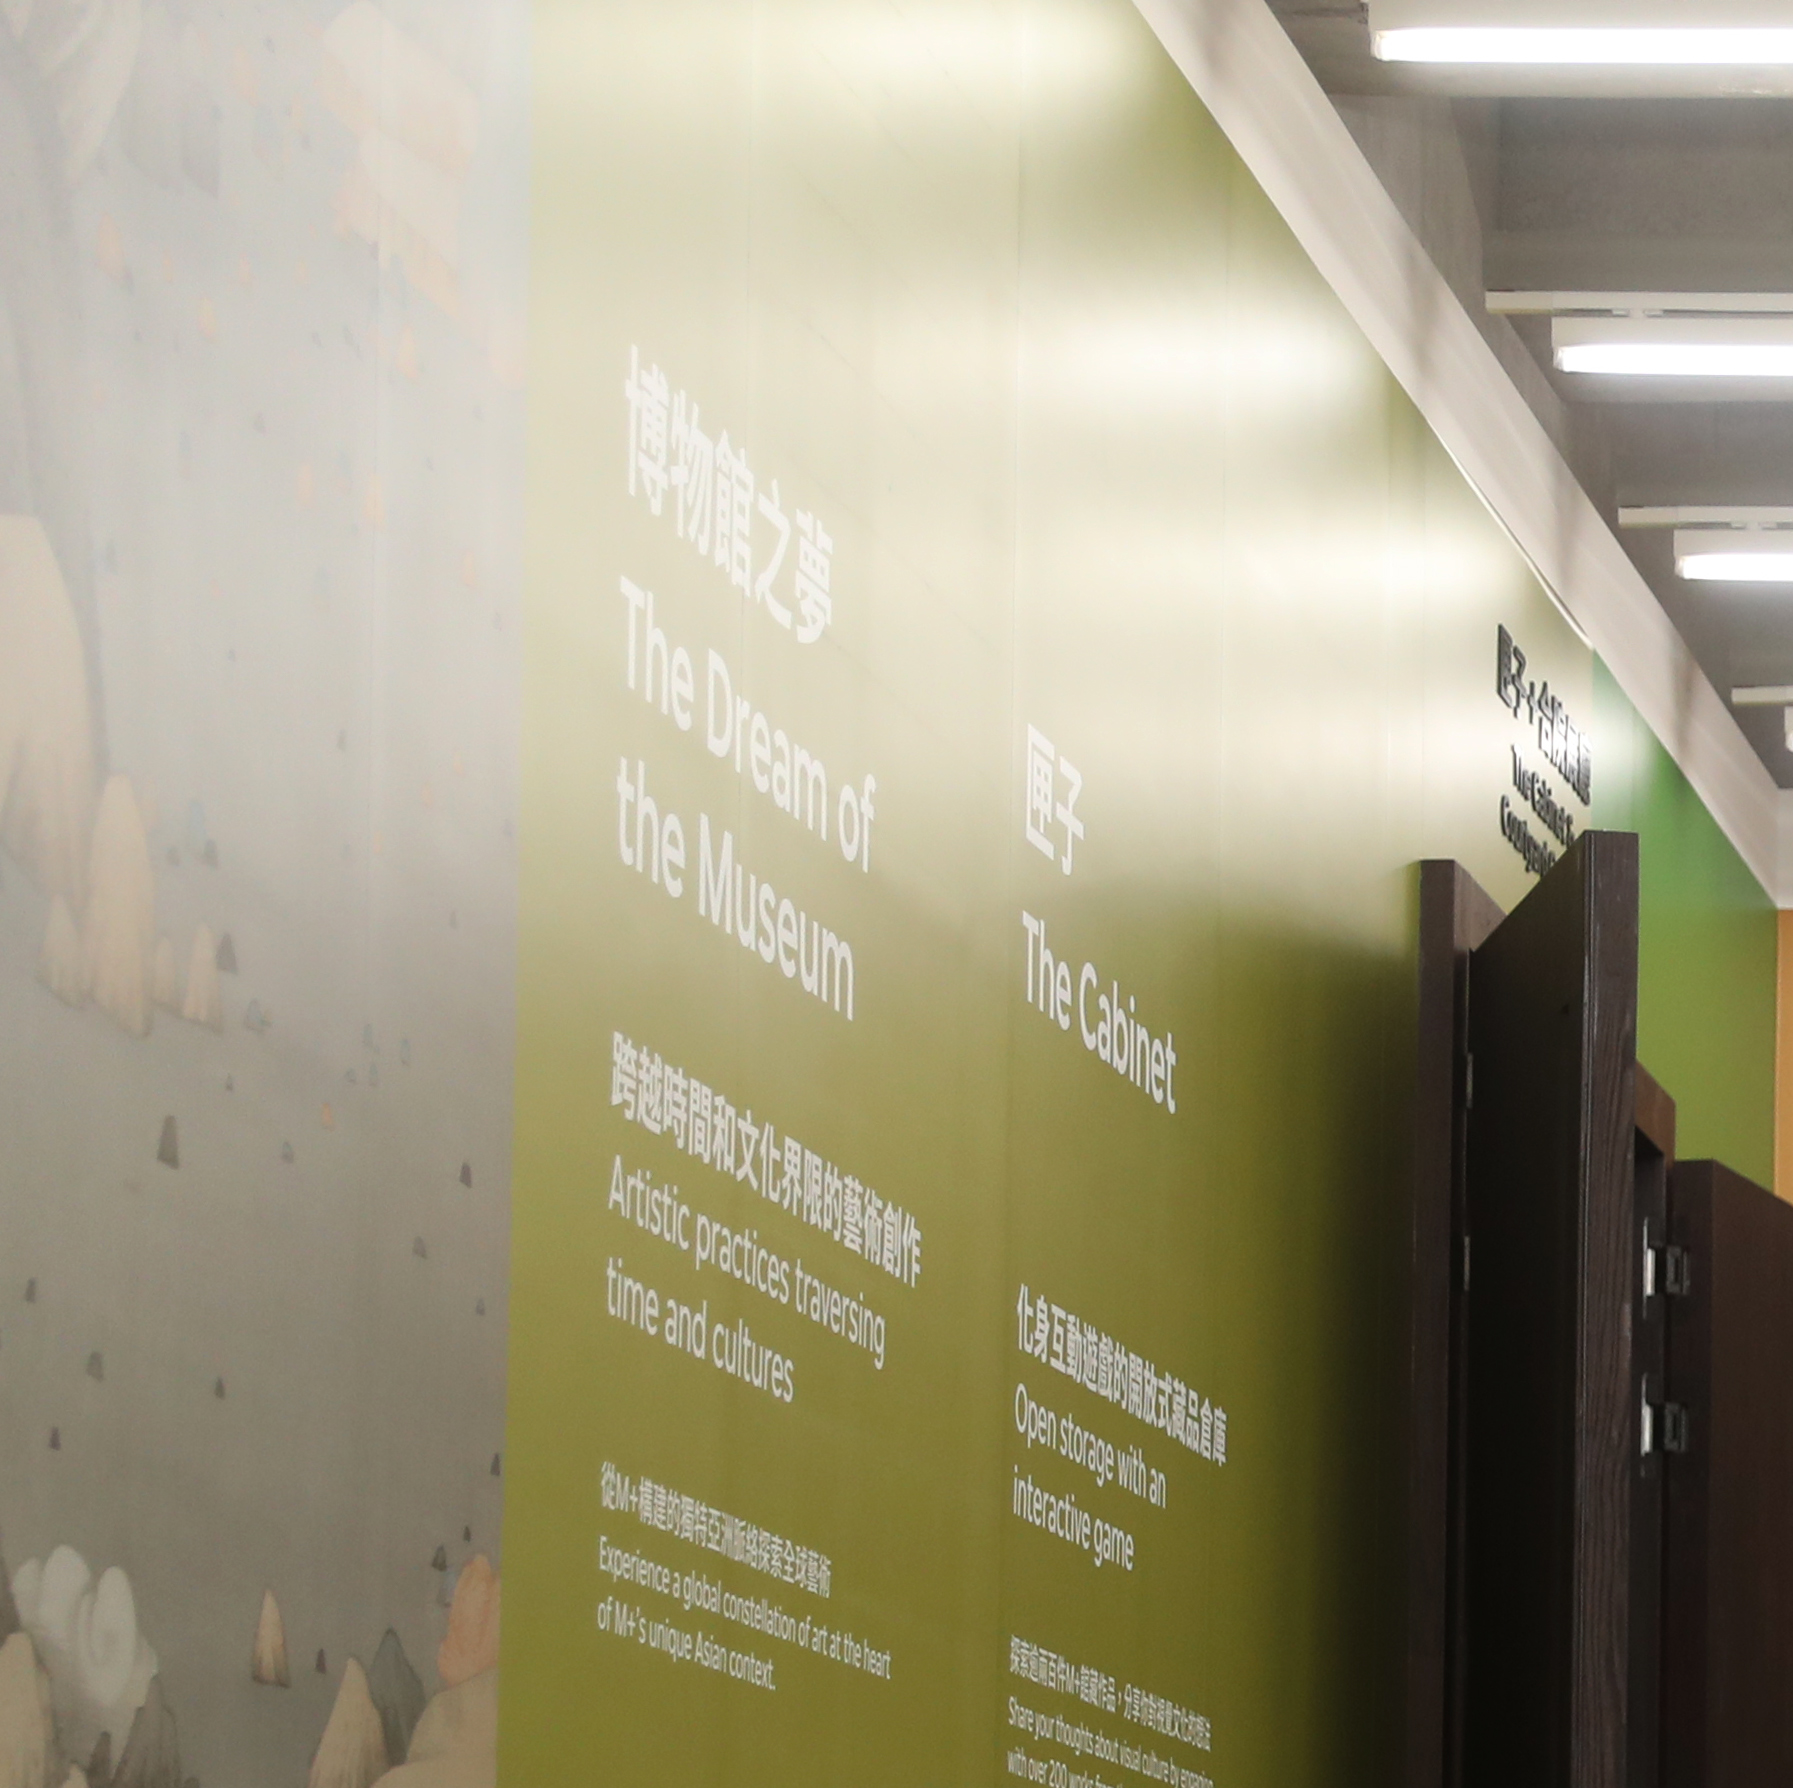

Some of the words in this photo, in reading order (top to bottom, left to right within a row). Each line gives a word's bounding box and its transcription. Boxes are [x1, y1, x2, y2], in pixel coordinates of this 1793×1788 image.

[624, 344, 834, 646] 博物館之夢
[620, 576, 695, 733] The
[708, 648, 827, 840] Dream
[839, 773, 877, 874] of
[1026, 723, 1085, 876] 匣子
[617, 757, 685, 898] the
[697, 813, 854, 1021] Museum
[1023, 910, 1072, 1032] The
[1080, 961, 1177, 1116] Cabinet
[611, 1030, 921, 1288] 跨越時間和文化界限的藝術創作
[607, 1257, 659, 1336] time
[665, 1298, 707, 1360] and
[712, 1317, 794, 1403] cultures
[608, 1154, 689, 1250] Artistic
[695, 1212, 789, 1304] practices
[795, 1258, 886, 1370] traversing
[1013, 1464, 1091, 1550] interactive
[1094, 1517, 1134, 1571] game
[1015, 1383, 1056, 1449] Open
[1060, 1412, 1114, 1488] storage
[1117, 1444, 1147, 1498] with
[1149, 1466, 1166, 1509] an
[597, 1595, 613, 1631] of
[649, 1618, 692, 1663] unique
[694, 1631, 728, 1673] Asian
[729, 1651, 777, 1691] context.
[600, 1534, 670, 1594] Experience
[672, 1571, 681, 1598] a
[683, 1570, 721, 1611] global
[723, 1590, 796, 1643] constellation
[797, 1615, 811, 1648] of
[812, 1625, 828, 1656] art
[829, 1632, 842, 1661] at
[843, 1632, 862, 1668] the
[863, 1638, 891, 1680] heart
[1008, 1696, 1033, 1732] Share
[1055, 1713, 1094, 1756] thoughts
[1095, 1730, 1119, 1764] about
